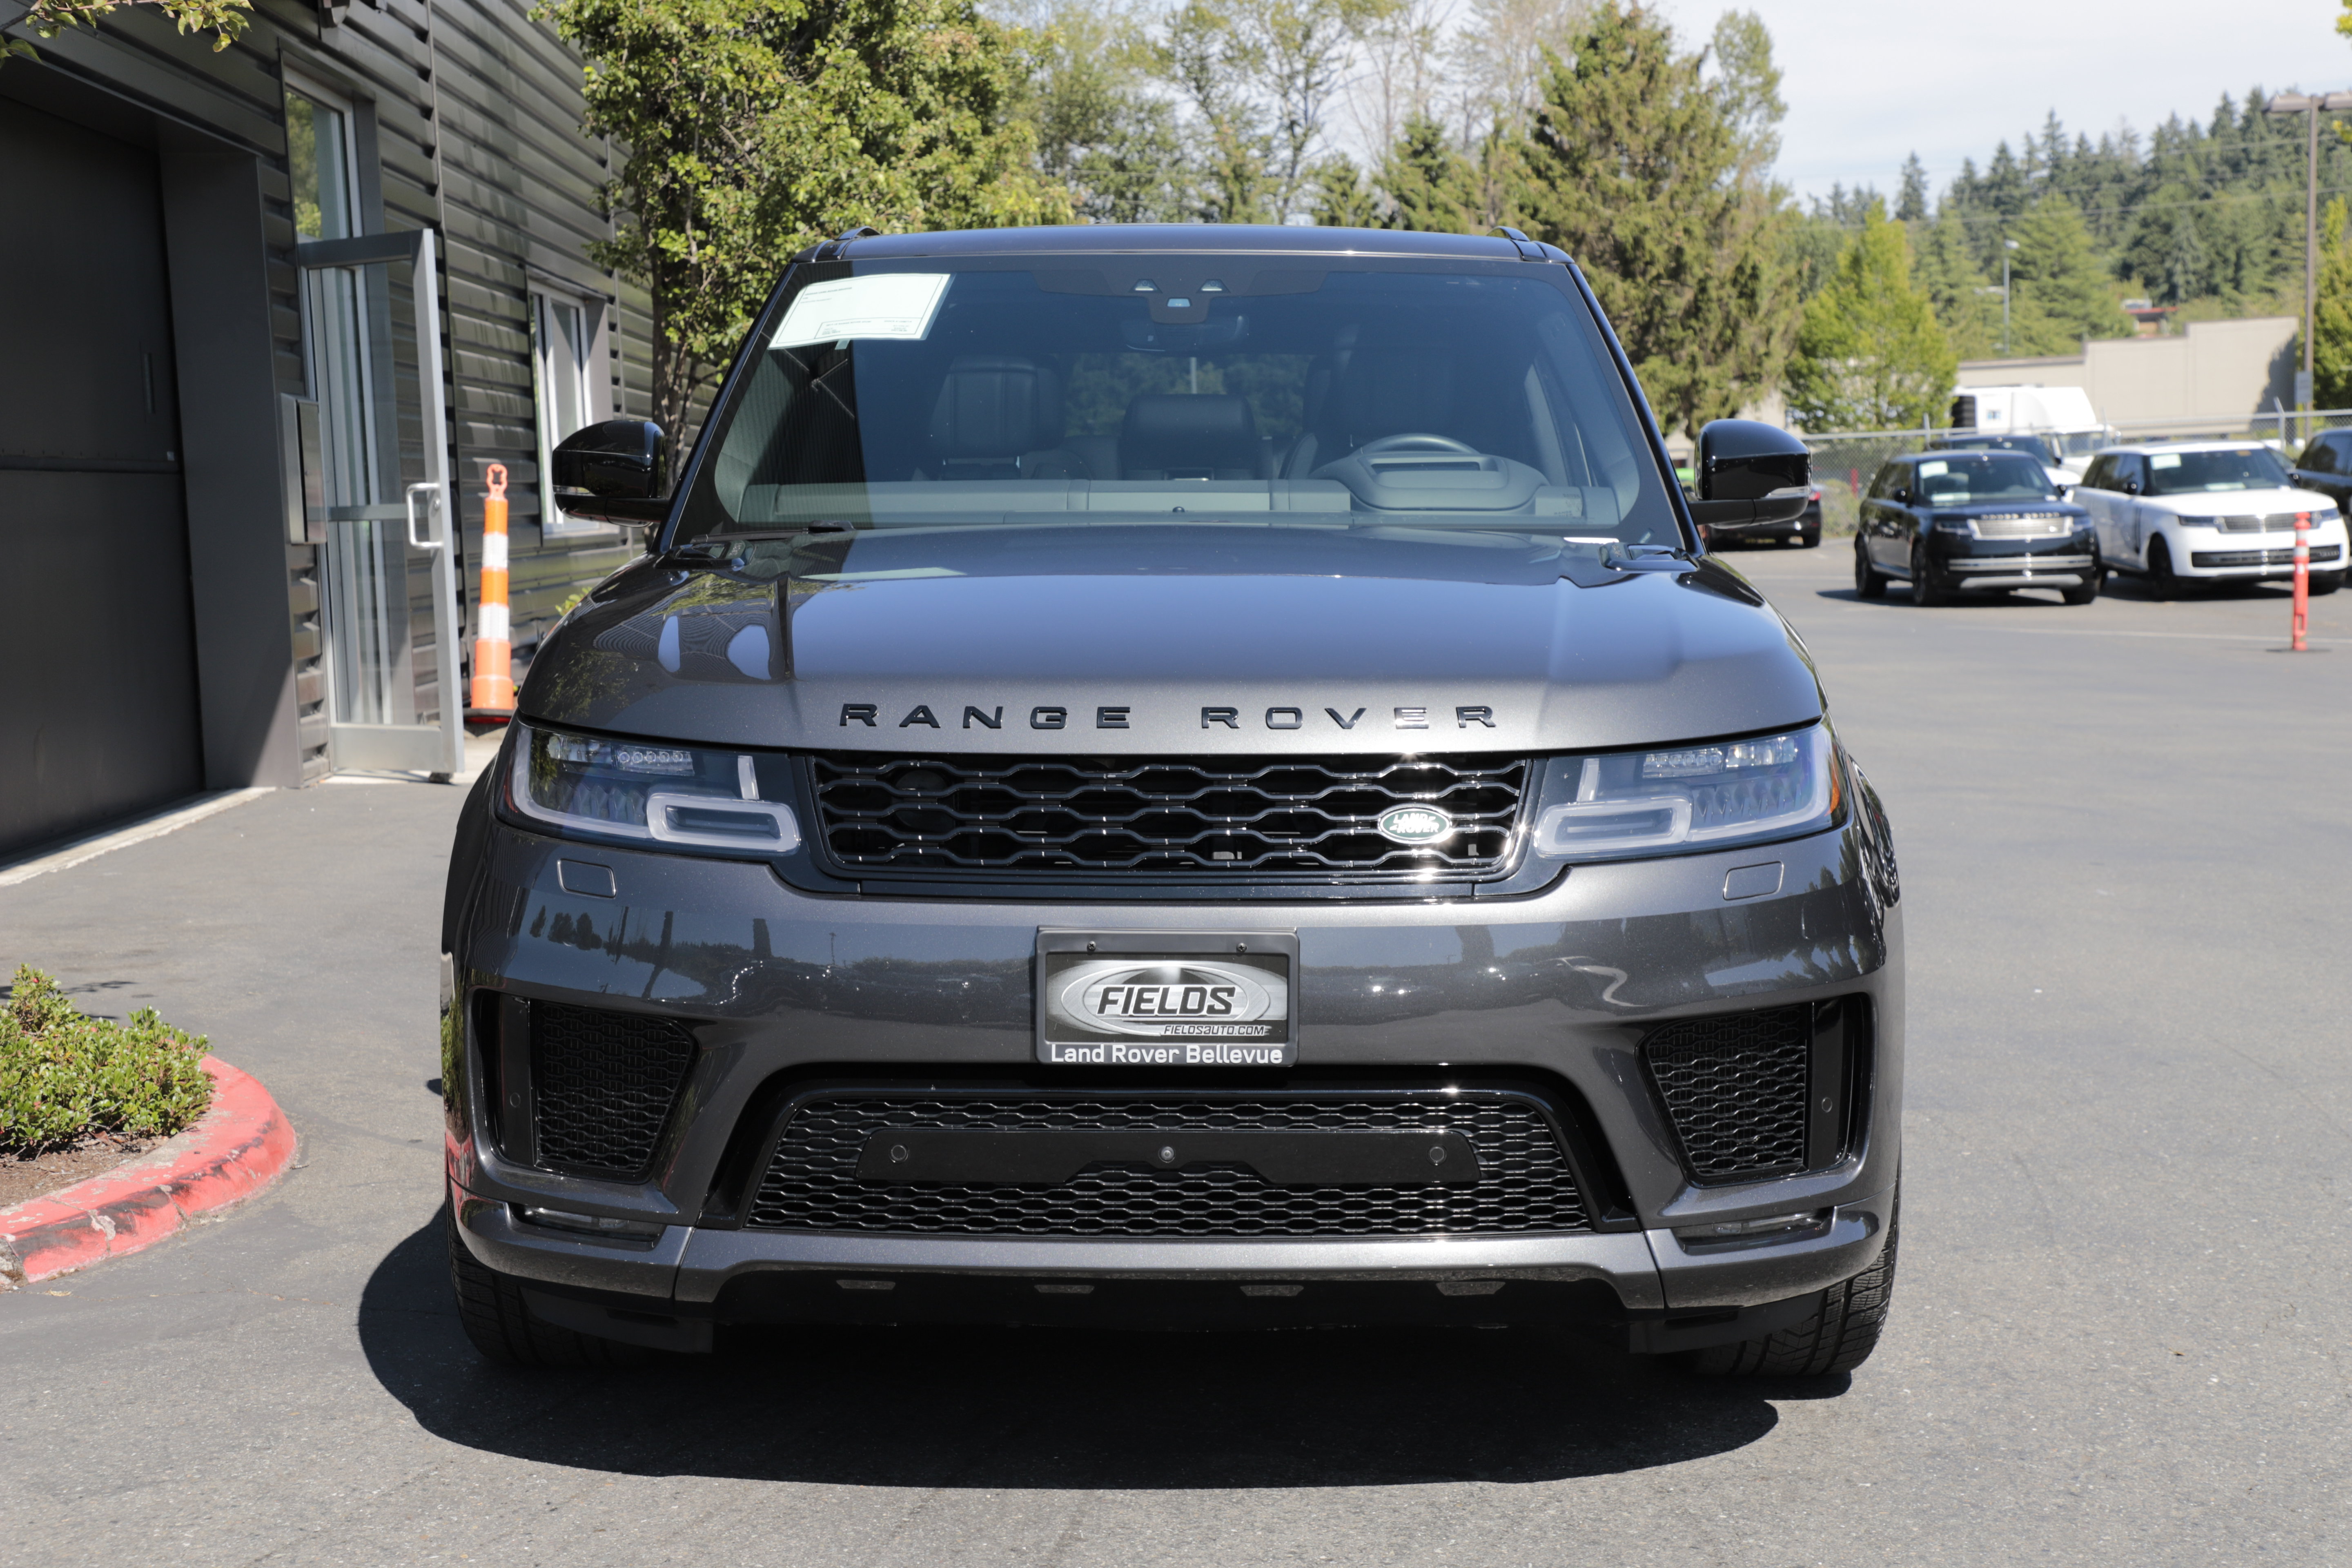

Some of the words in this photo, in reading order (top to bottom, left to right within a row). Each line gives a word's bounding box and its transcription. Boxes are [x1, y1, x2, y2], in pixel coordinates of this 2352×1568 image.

[840, 703, 1131, 729] RANGE
[1201, 706, 1496, 729] ROVER
[1393, 813, 1428, 824] LAND
[1396, 822, 1440, 833] ROVER
[1096, 986, 1236, 1016] FIELDS
[1051, 1044, 1105, 1063] Land
[1112, 1045, 1180, 1063] Rover
[1186, 1044, 1283, 1064] Bellevue
